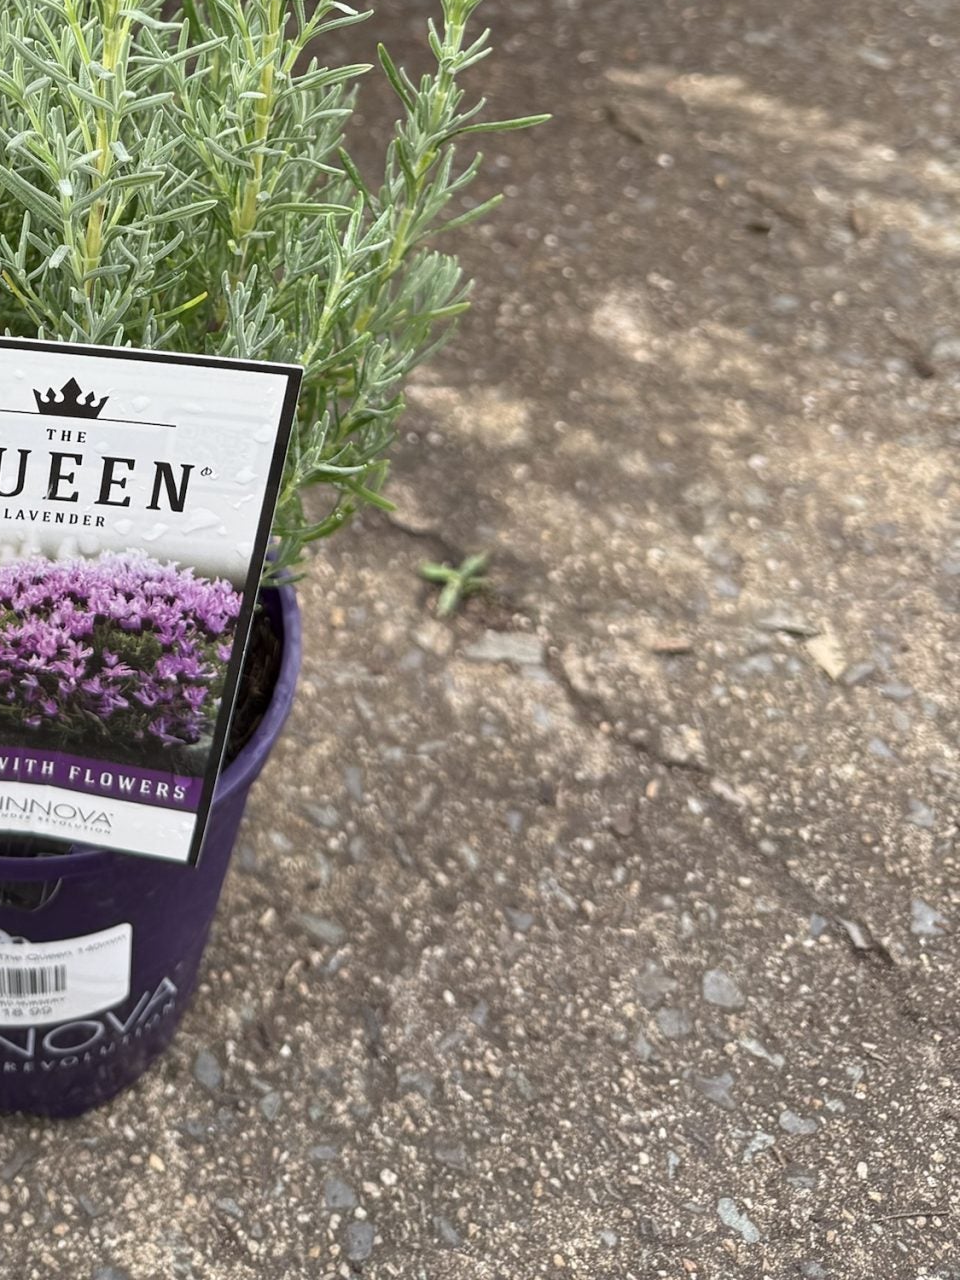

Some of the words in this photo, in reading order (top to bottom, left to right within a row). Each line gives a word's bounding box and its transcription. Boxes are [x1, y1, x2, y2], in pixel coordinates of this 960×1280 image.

[46, 428, 87, 443] THE
[3, 508, 106, 527] LAVENDER
[68, 765, 186, 799] FLOWERS
[38, 816, 112, 835] REVOLUTION
